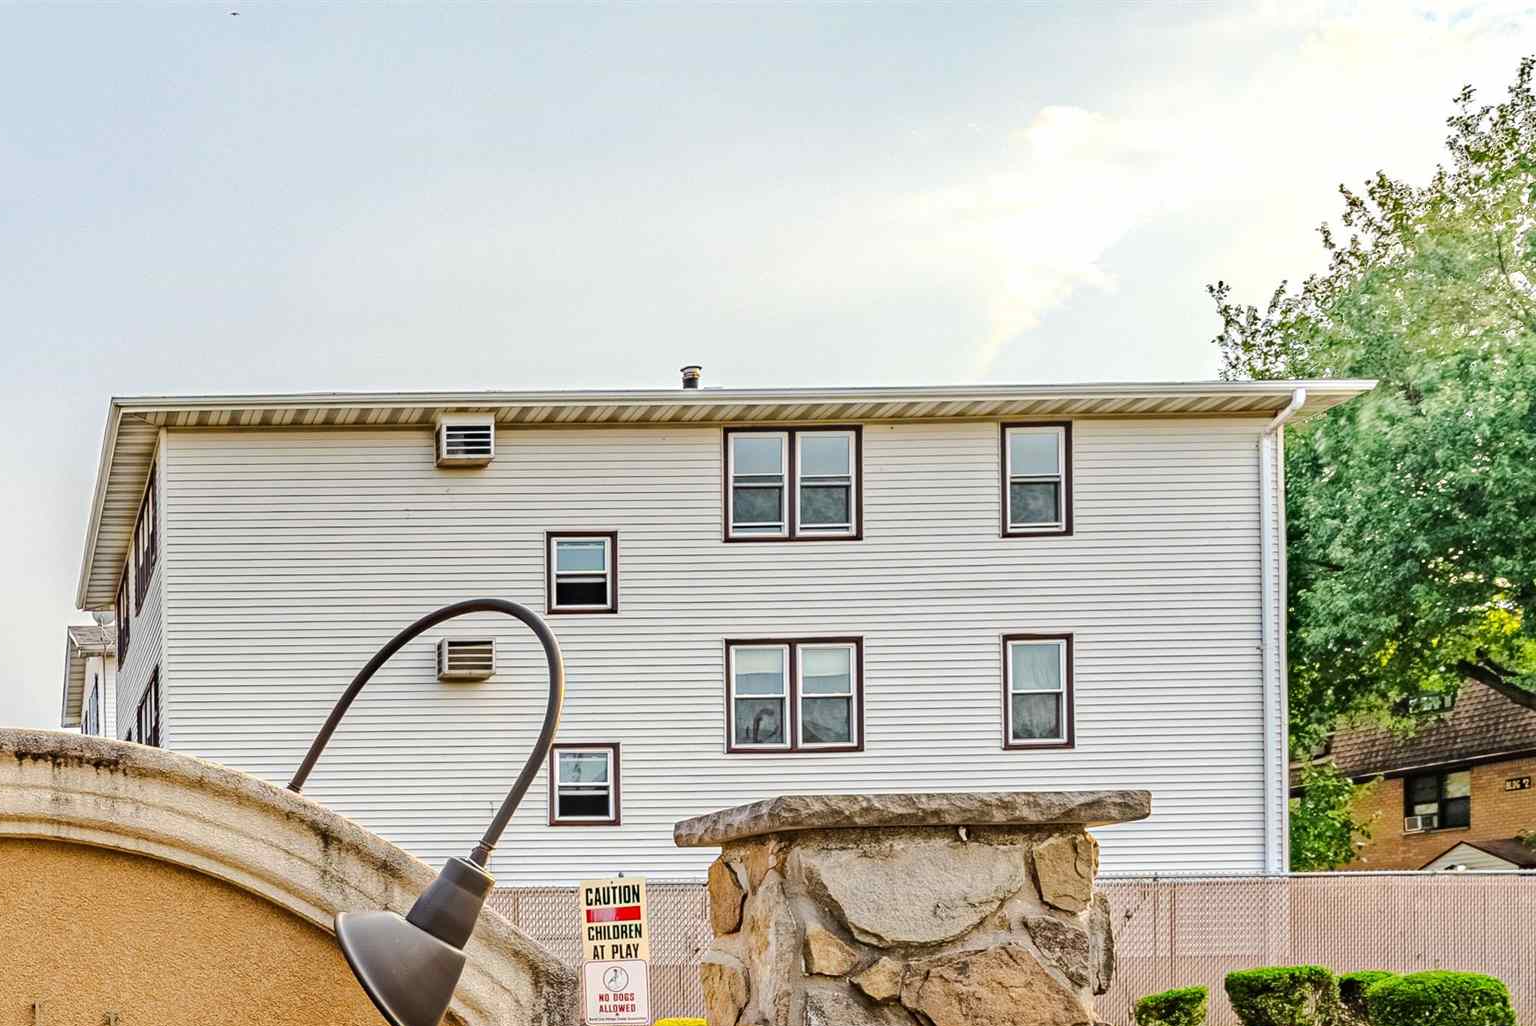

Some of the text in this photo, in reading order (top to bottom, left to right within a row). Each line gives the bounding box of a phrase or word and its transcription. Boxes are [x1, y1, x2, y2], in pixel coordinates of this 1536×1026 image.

[585, 884, 640, 906] CAUTION
[587, 923, 642, 941] CHILDREN
[592, 943, 639, 960] AT PLAY
[598, 992, 635, 1002] NO DOGS
[599, 1003, 636, 1013] ALLOWED
